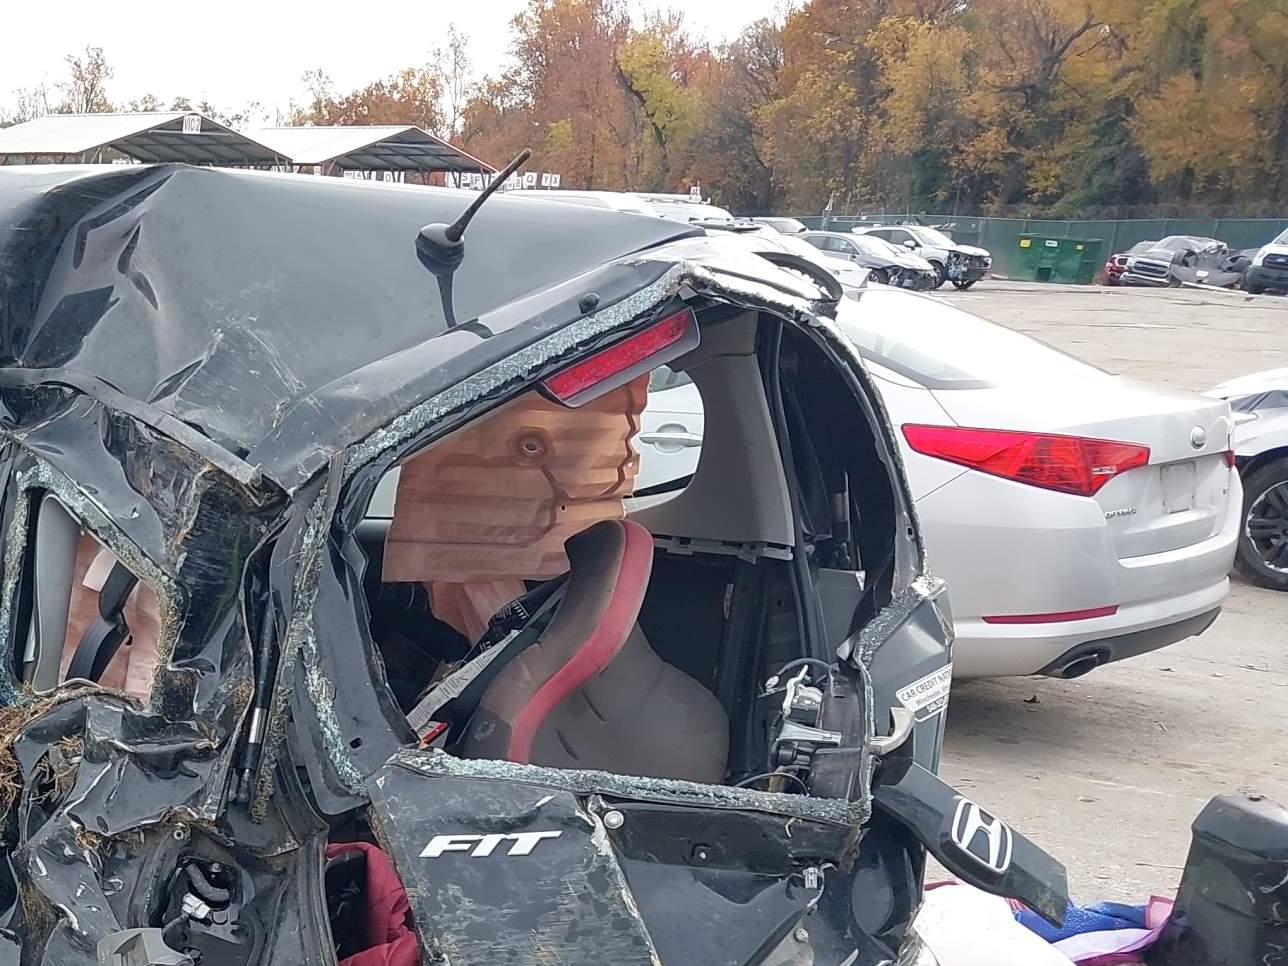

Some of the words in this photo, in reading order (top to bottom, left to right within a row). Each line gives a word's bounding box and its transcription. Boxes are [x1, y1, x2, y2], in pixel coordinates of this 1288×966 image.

[902, 689, 918, 701] CAR
[916, 677, 939, 693] CREDIT
[418, 831, 563, 858] FIT
